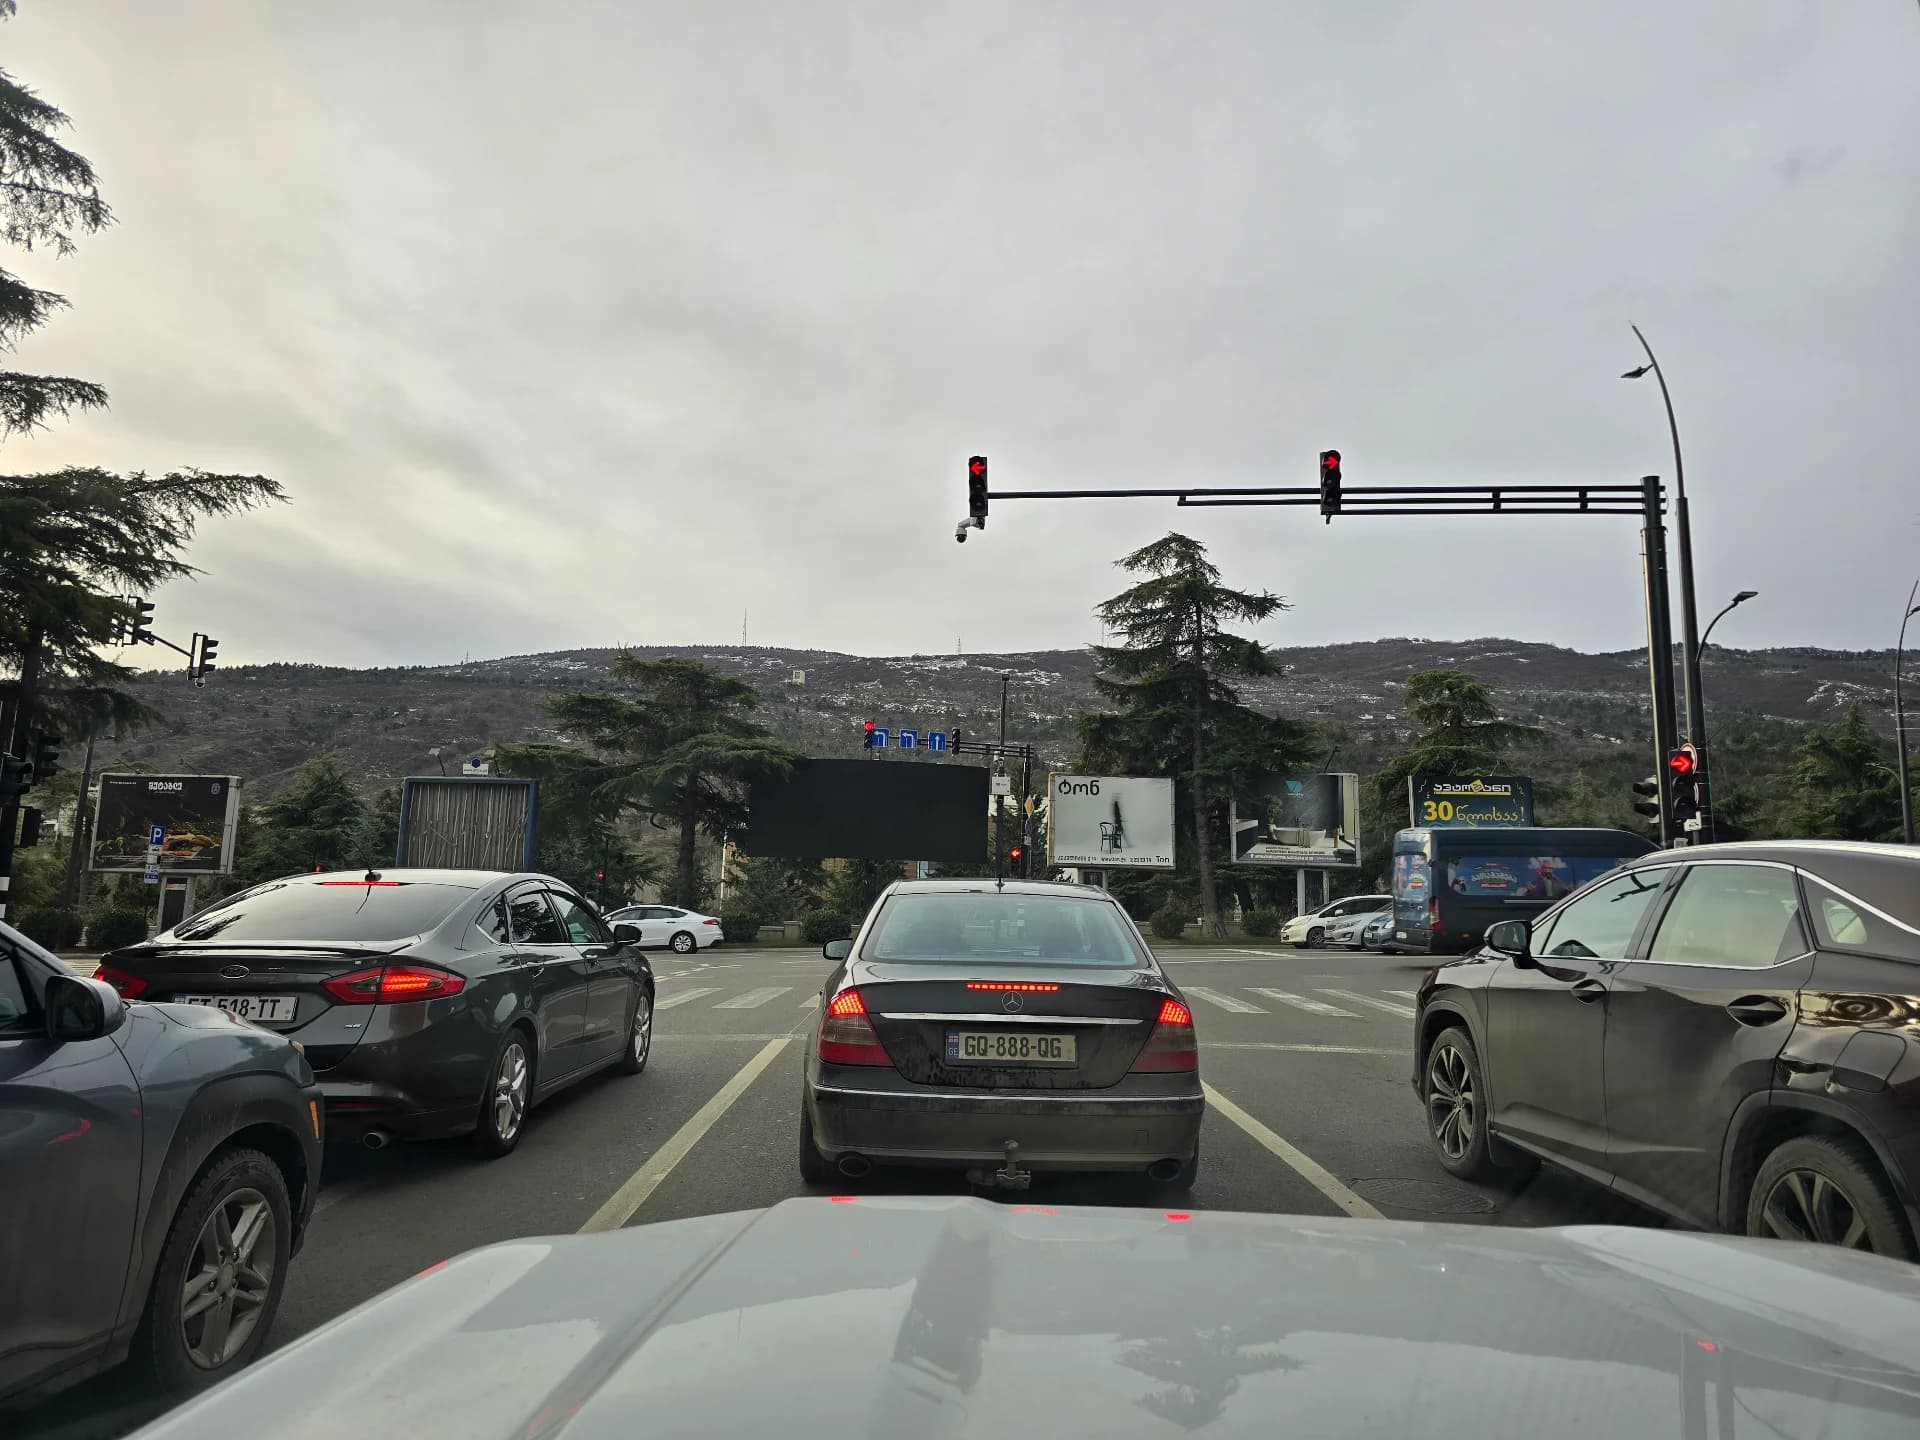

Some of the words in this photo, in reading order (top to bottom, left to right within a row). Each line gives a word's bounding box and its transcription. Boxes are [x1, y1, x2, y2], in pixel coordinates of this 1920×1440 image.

[1058, 779, 1100, 796] თონ
[1423, 800, 1454, 821] 30
[152, 827, 162, 843] P
[1155, 855, 1170, 864] Ton
[964, 1035, 1062, 1058] GQ-888-QG
